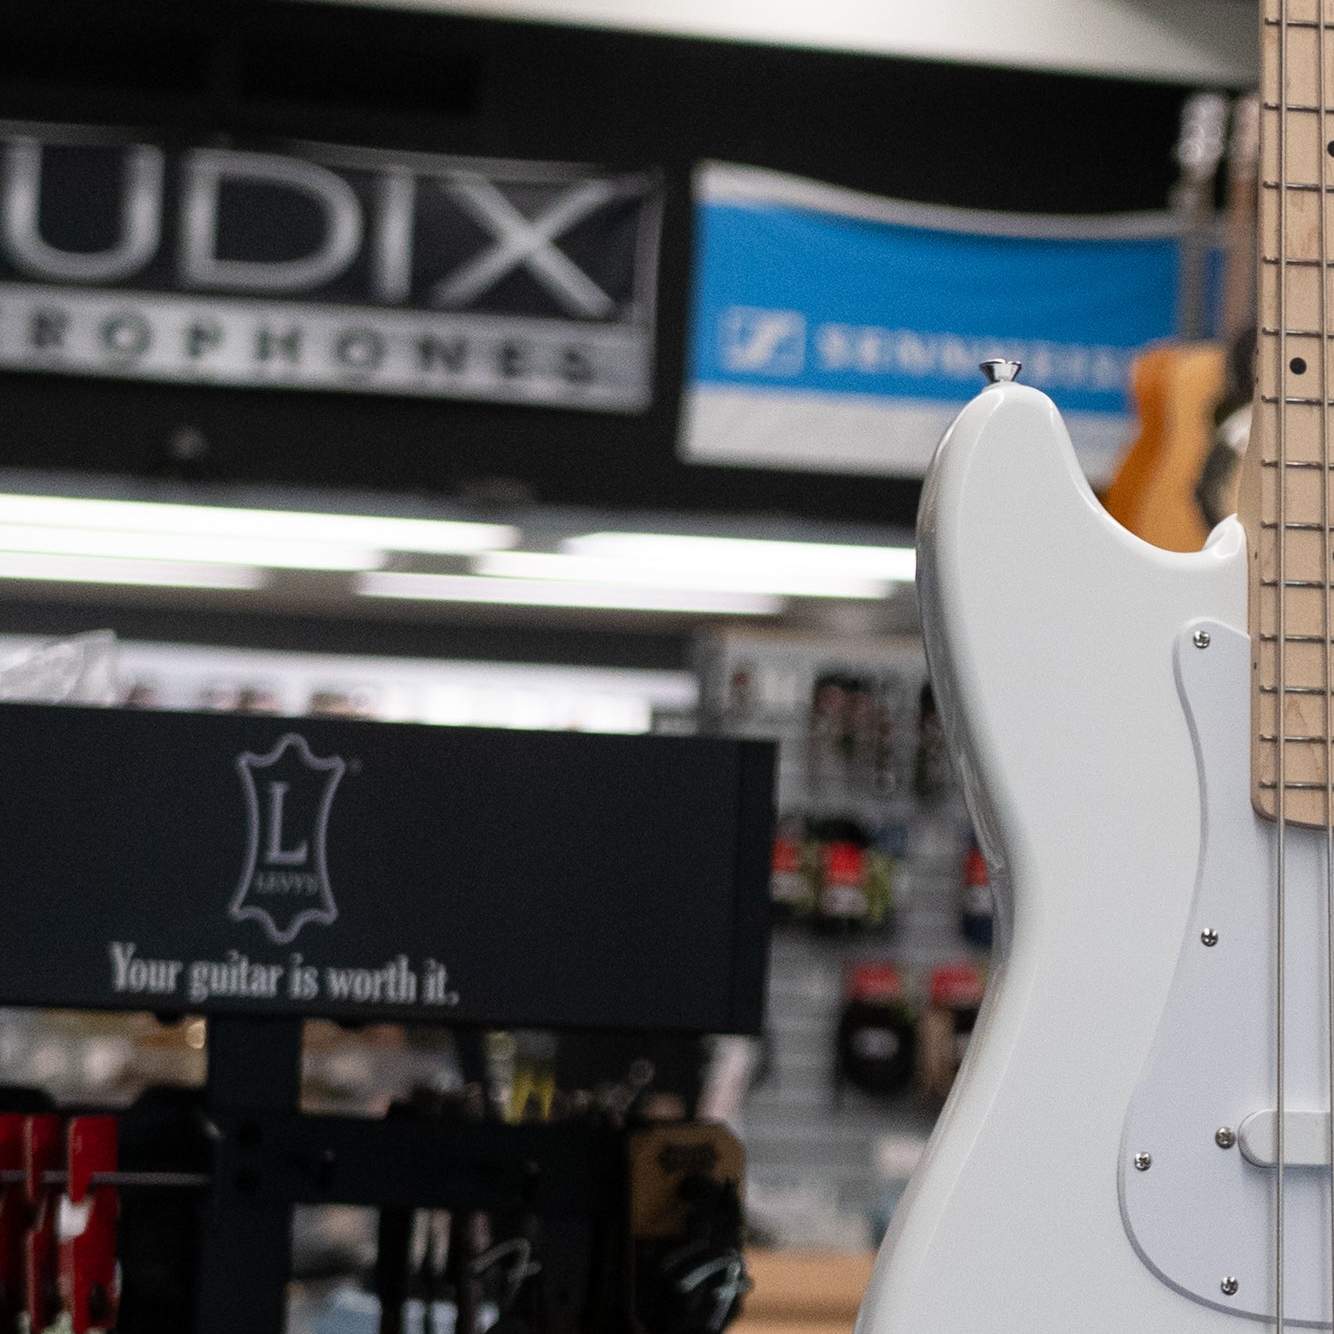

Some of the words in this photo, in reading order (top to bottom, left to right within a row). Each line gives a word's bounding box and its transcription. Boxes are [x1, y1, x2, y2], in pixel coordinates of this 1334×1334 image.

[267, 781, 307, 864] L
[109, 941, 183, 993] Your
[188, 949, 284, 1003] guitar
[290, 952, 319, 1000] is
[327, 953, 418, 1005] worth
[421, 957, 460, 1006] it.
